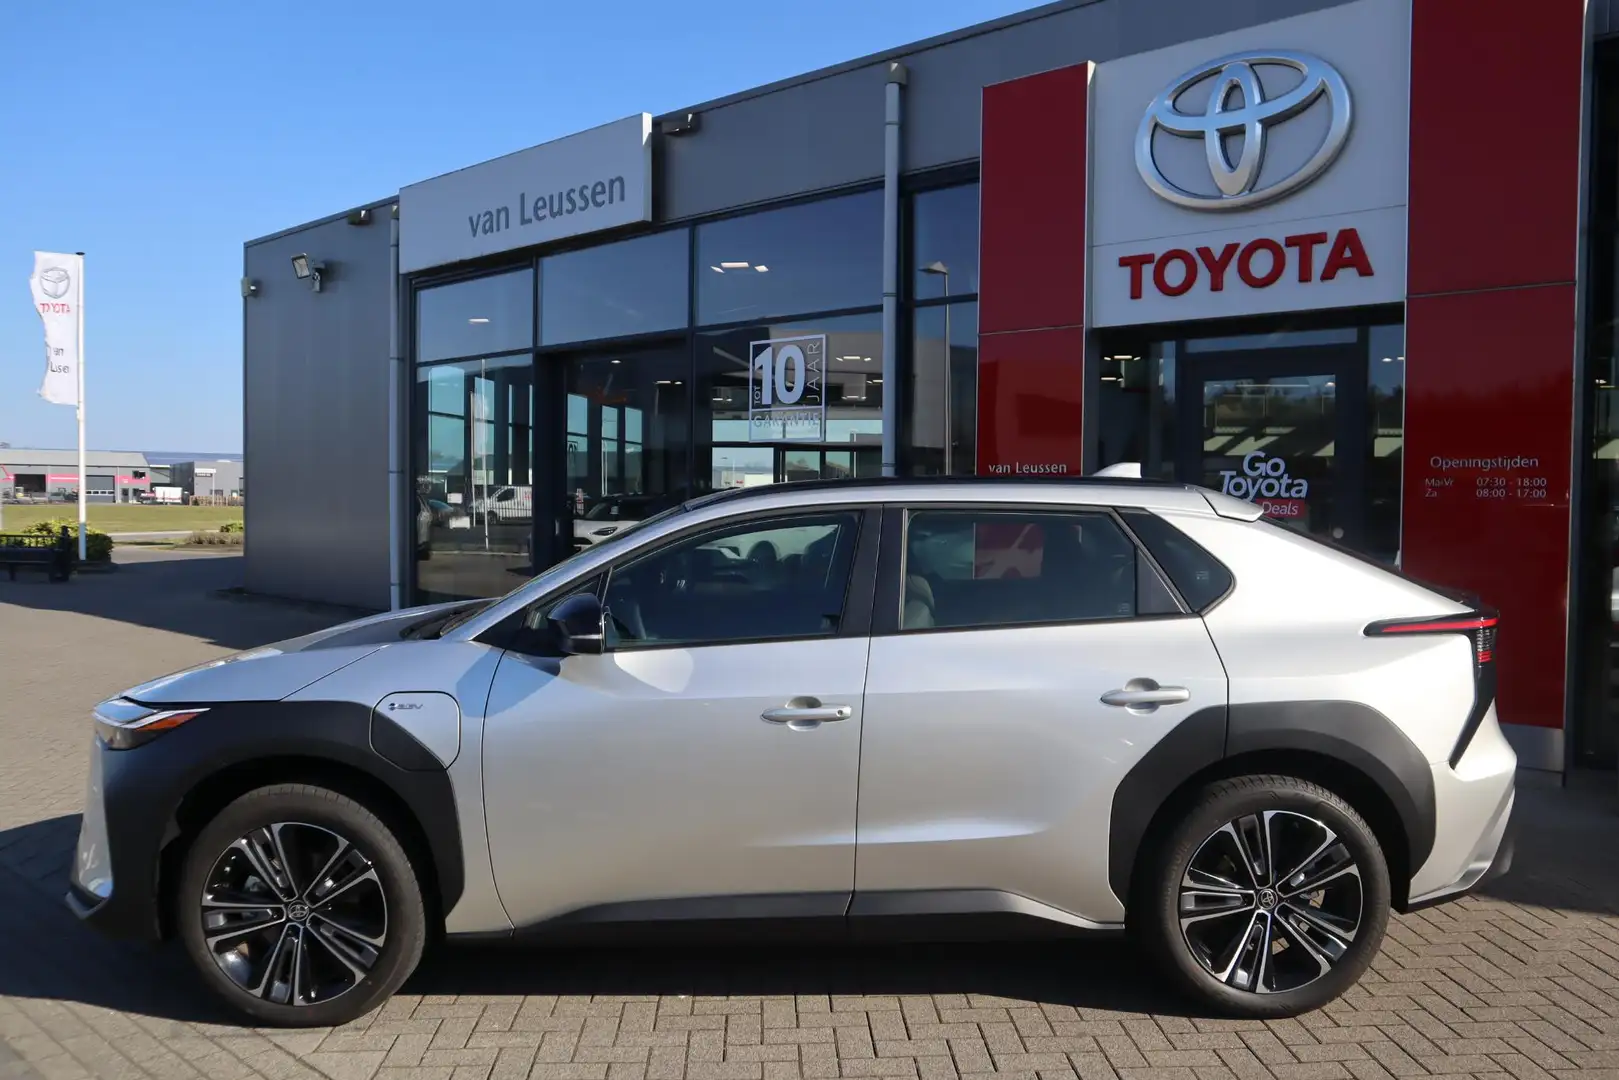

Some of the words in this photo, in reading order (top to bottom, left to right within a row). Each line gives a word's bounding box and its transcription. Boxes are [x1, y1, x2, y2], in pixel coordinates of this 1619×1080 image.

[468, 205, 510, 238] van
[519, 175, 625, 226] Leussen
[1118, 227, 1375, 300] TOYOTA
[754, 344, 806, 405] 10
[806, 342, 820, 402] JAAR
[754, 412, 819, 428] GARANTIE
[988, 464, 1011, 473] van
[1016, 461, 1067, 474] Leussen
[1242, 450, 1286, 477] Go
[1430, 456, 1539, 472] Openingstijden
[1220, 470, 1309, 502] Toyota
[1476, 477, 1506, 487] 07:30
[1517, 477, 1547, 487] 18:00
[1425, 488, 1438, 497] Za
[1476, 488, 1506, 498] 08:00
[1517, 488, 1547, 498] 17:00
[1262, 501, 1299, 515] Deals
